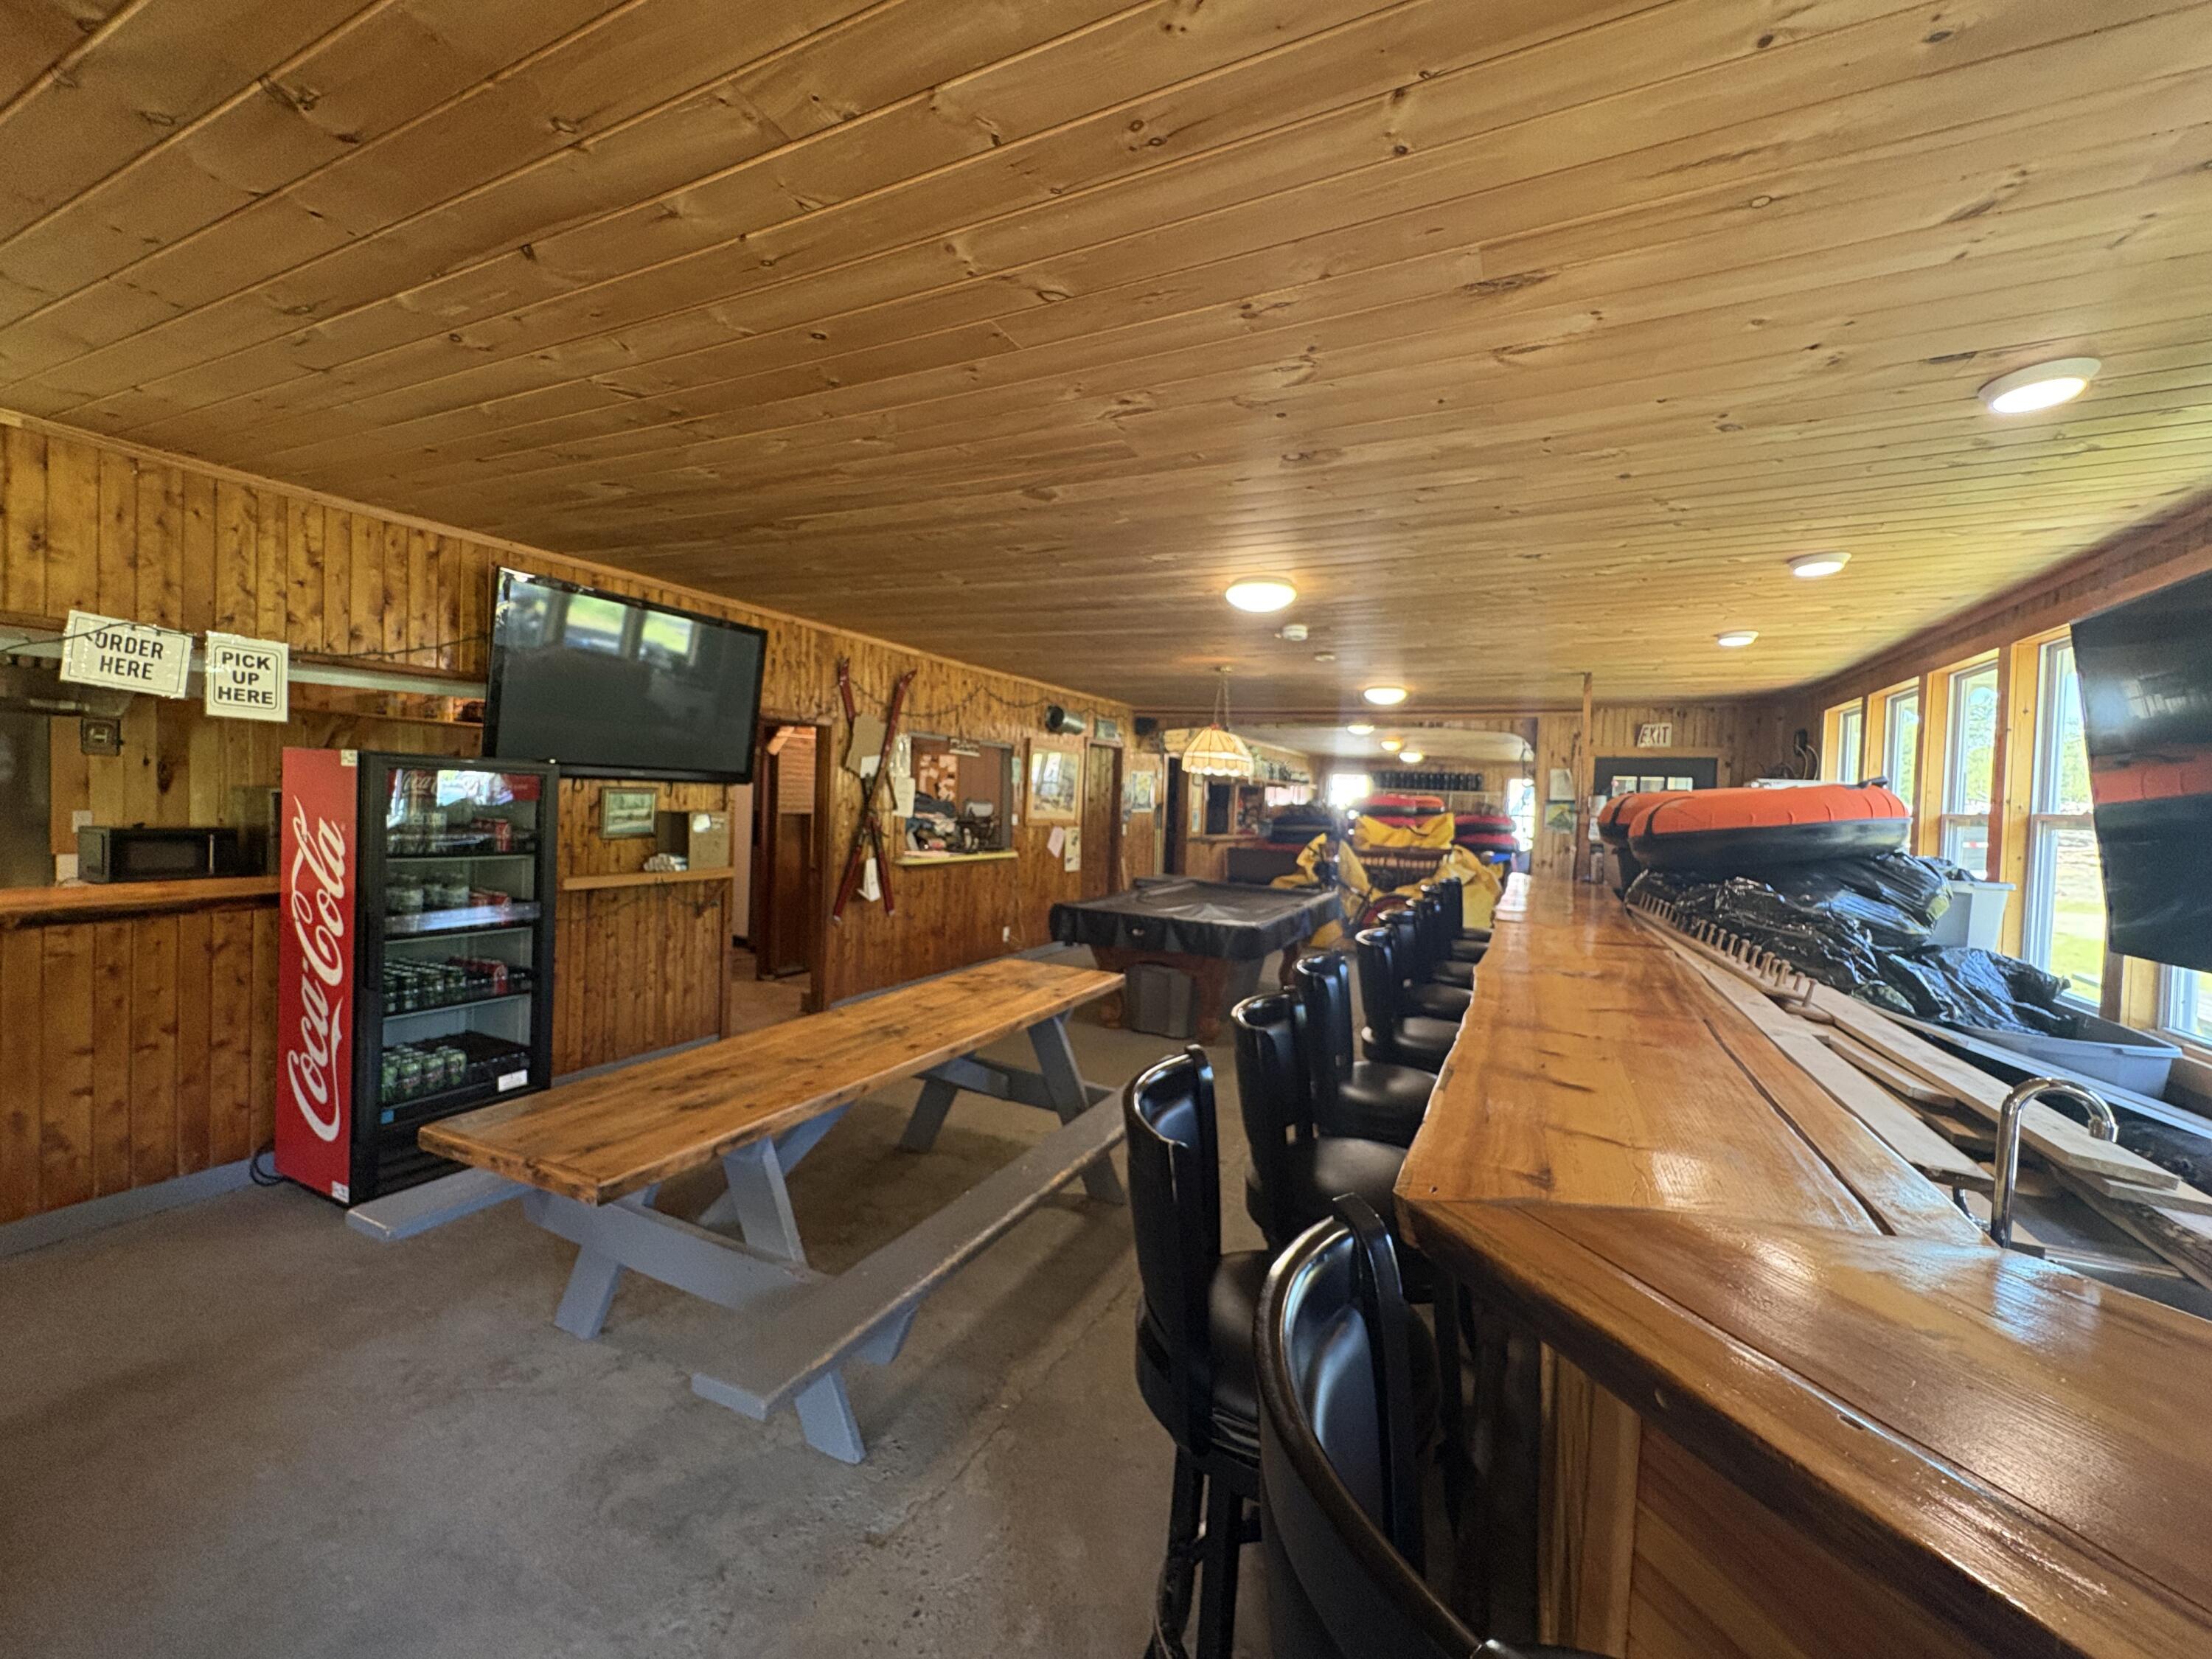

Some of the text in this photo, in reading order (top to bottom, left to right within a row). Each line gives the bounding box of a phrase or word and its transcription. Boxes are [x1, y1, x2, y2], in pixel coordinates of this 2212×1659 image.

[95, 631, 164, 660] ORDER
[100, 655, 154, 681] HERE
[221, 651, 271, 670] PICK
[232, 670, 260, 686] UP
[218, 686, 274, 705] HERE
[1640, 726, 1669, 744] EXIT
[287, 795, 346, 1141] Coca-Cola
